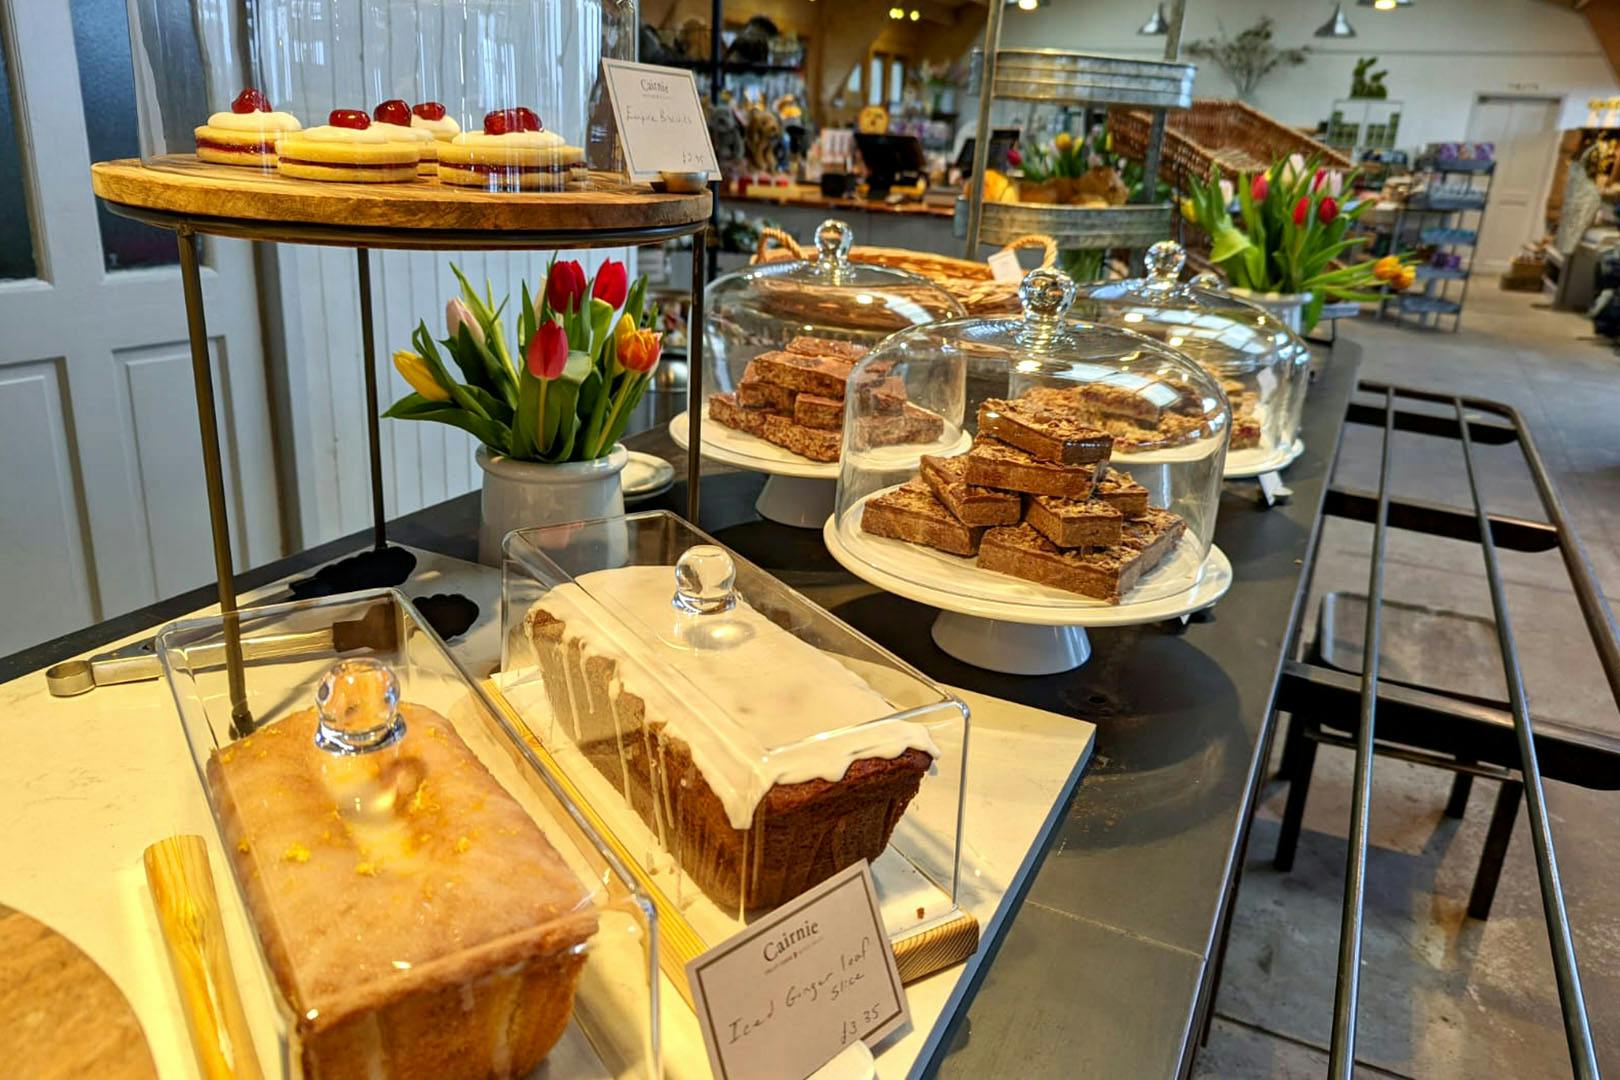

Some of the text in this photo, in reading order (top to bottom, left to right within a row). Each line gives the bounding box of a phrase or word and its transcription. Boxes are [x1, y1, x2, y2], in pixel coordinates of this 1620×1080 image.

[640, 78, 669, 94] Cairnie
[762, 920, 819, 962] Cairnie
[728, 1000, 775, 1044] Iced
[785, 972, 834, 1007] Ginger
